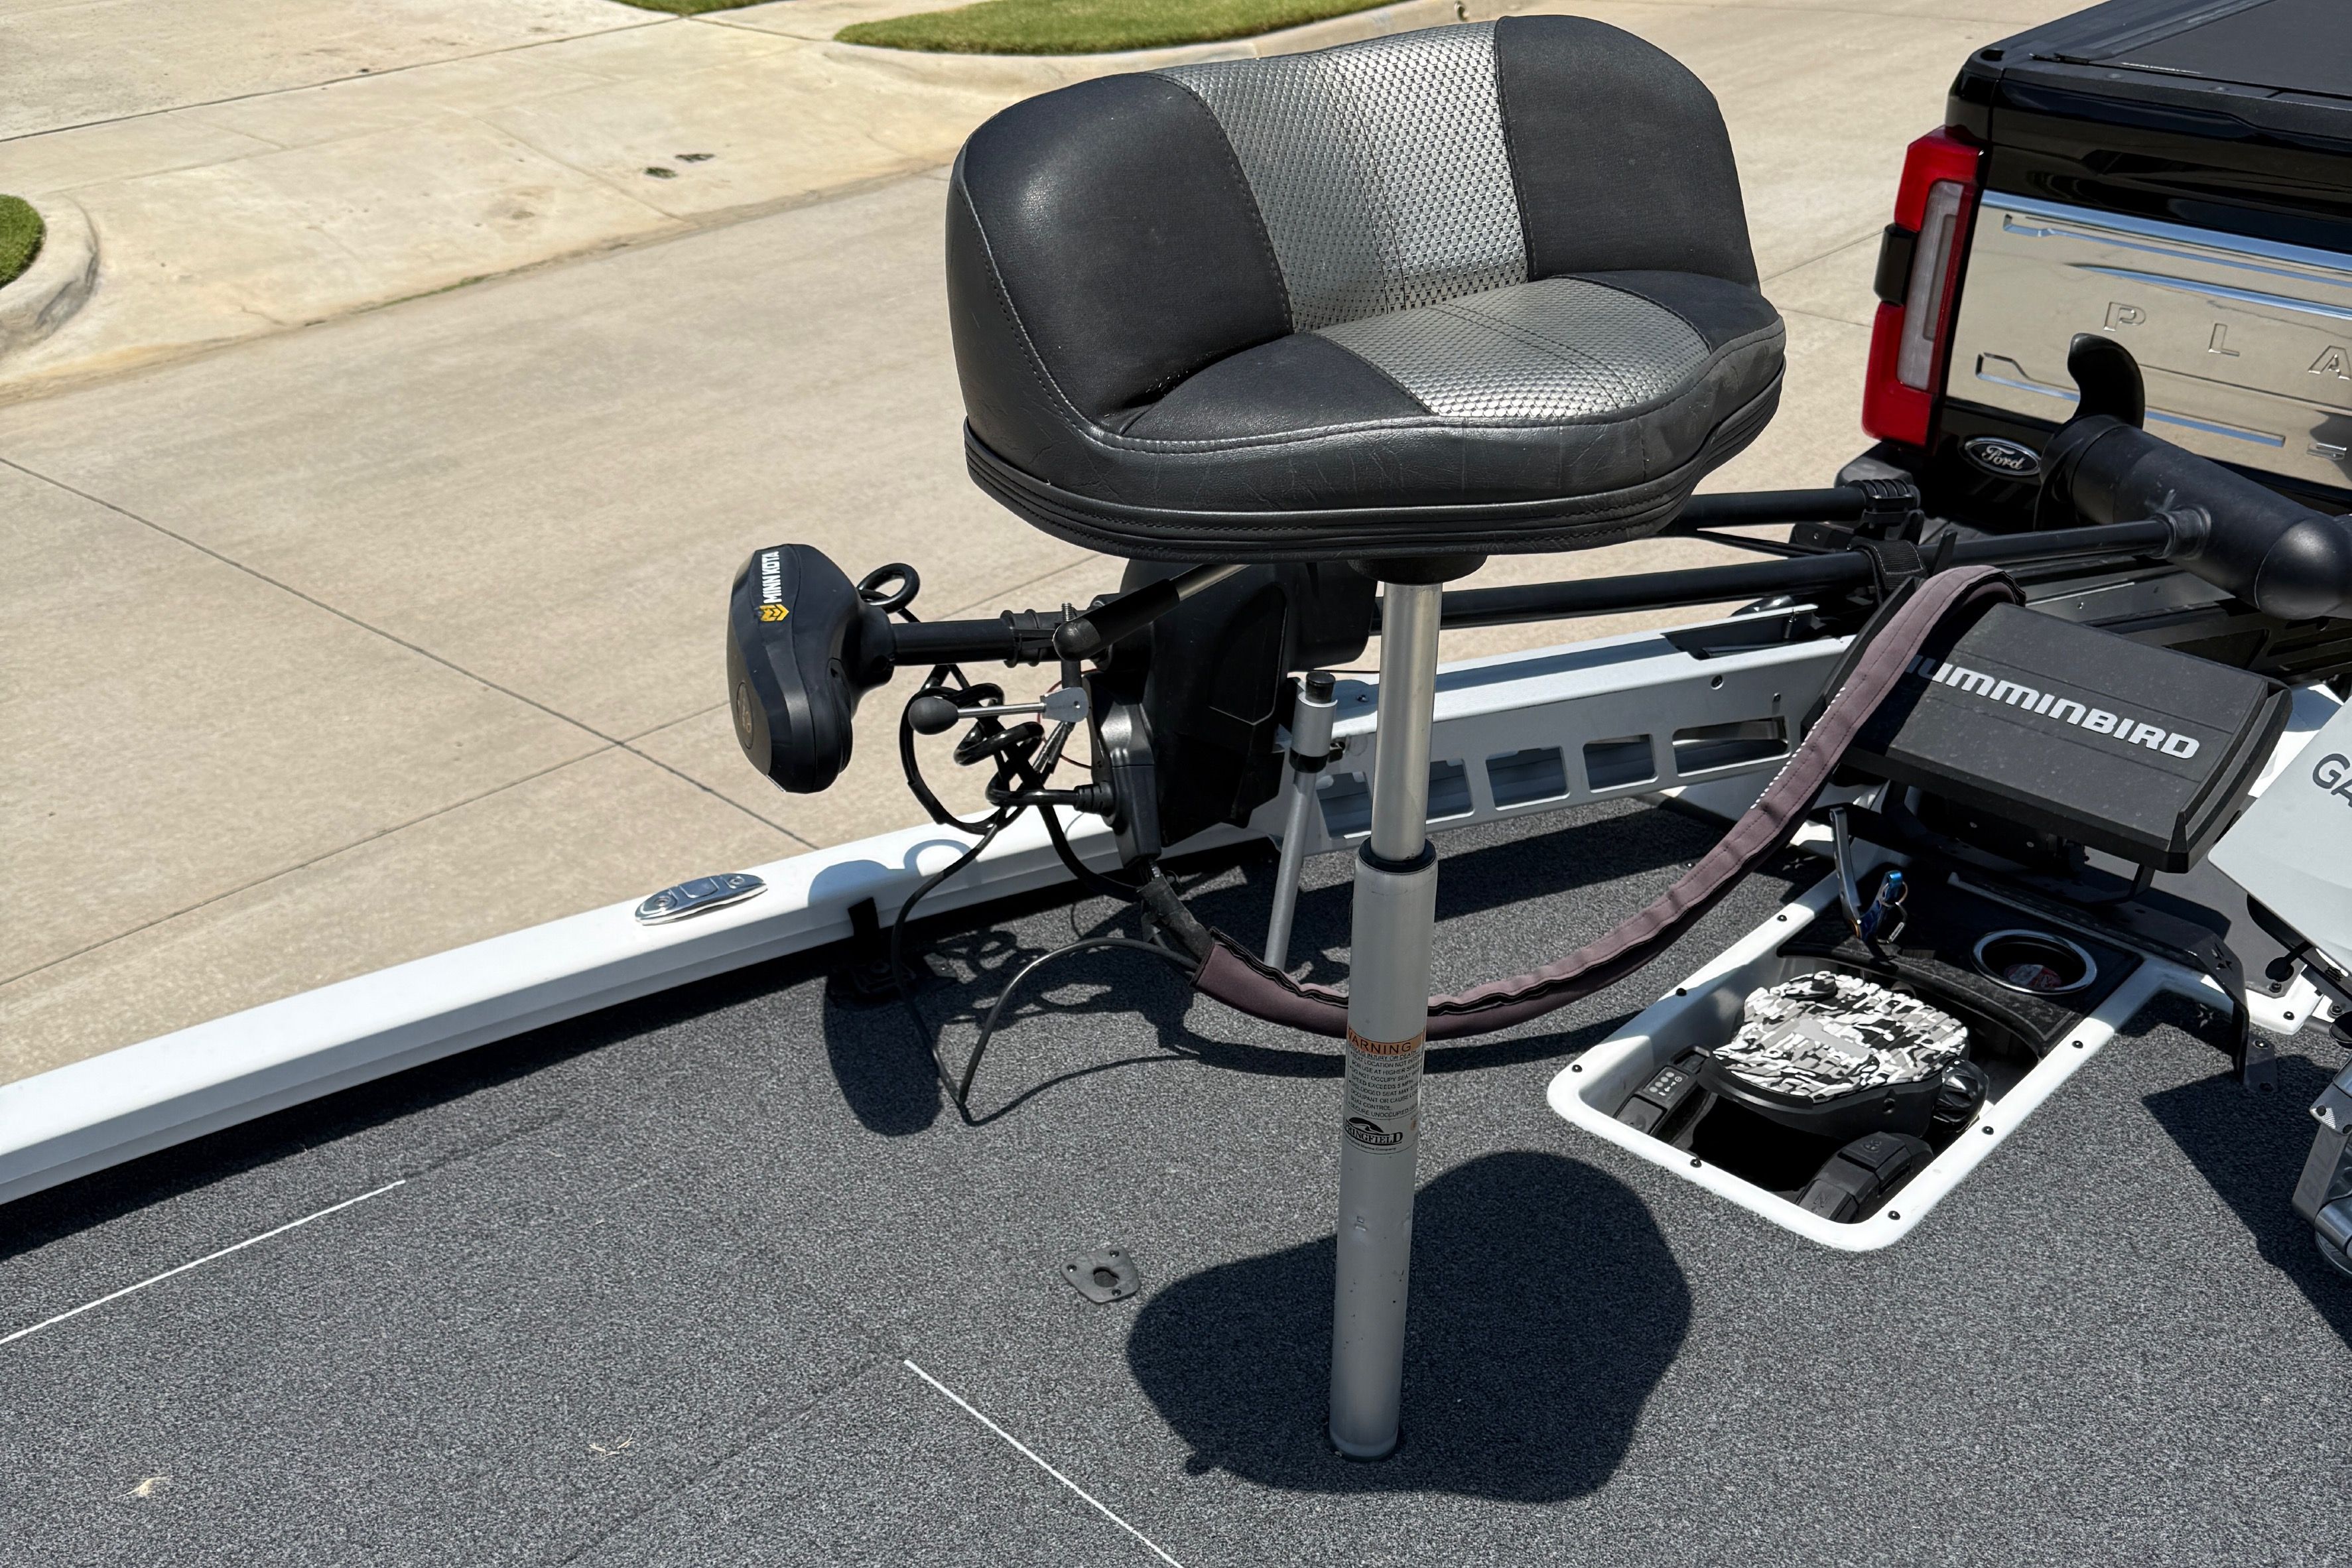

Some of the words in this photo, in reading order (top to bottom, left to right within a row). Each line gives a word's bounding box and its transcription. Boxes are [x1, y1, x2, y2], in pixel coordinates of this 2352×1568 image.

[1981, 445, 2025, 471] Ford
[761, 551, 780, 575] KOTA
[762, 574, 782, 603] MINN
[1398, 1072, 1410, 1081] SEAT
[1371, 1108, 1409, 1118] UNOCCUPIED
[1344, 1122, 1404, 1144] RINGFIELD
